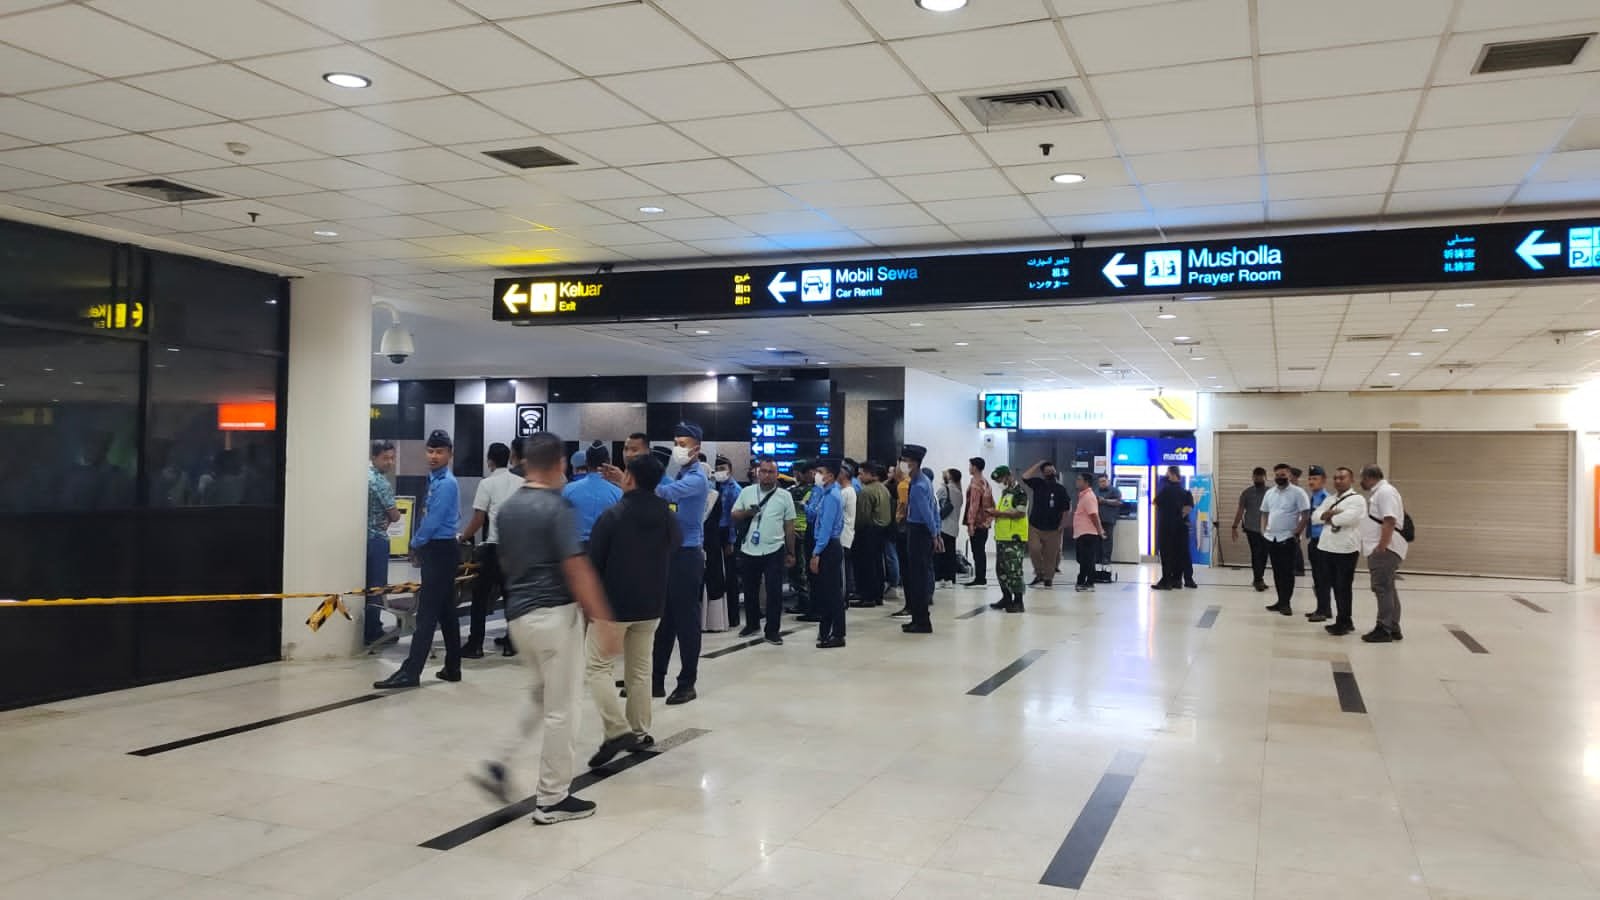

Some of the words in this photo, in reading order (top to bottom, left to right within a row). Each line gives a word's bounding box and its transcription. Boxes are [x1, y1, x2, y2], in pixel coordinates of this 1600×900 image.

[1188, 244, 1283, 269] Musholla
[835, 267, 874, 284] Mobil
[877, 265, 918, 282] Sewa
[1188, 271, 1235, 287] Prayer
[1238, 268, 1282, 282] Room
[559, 281, 604, 298] Keluar
[835, 287, 852, 298] Car
[853, 286, 883, 298] Rental
[559, 300, 577, 312] Exit
